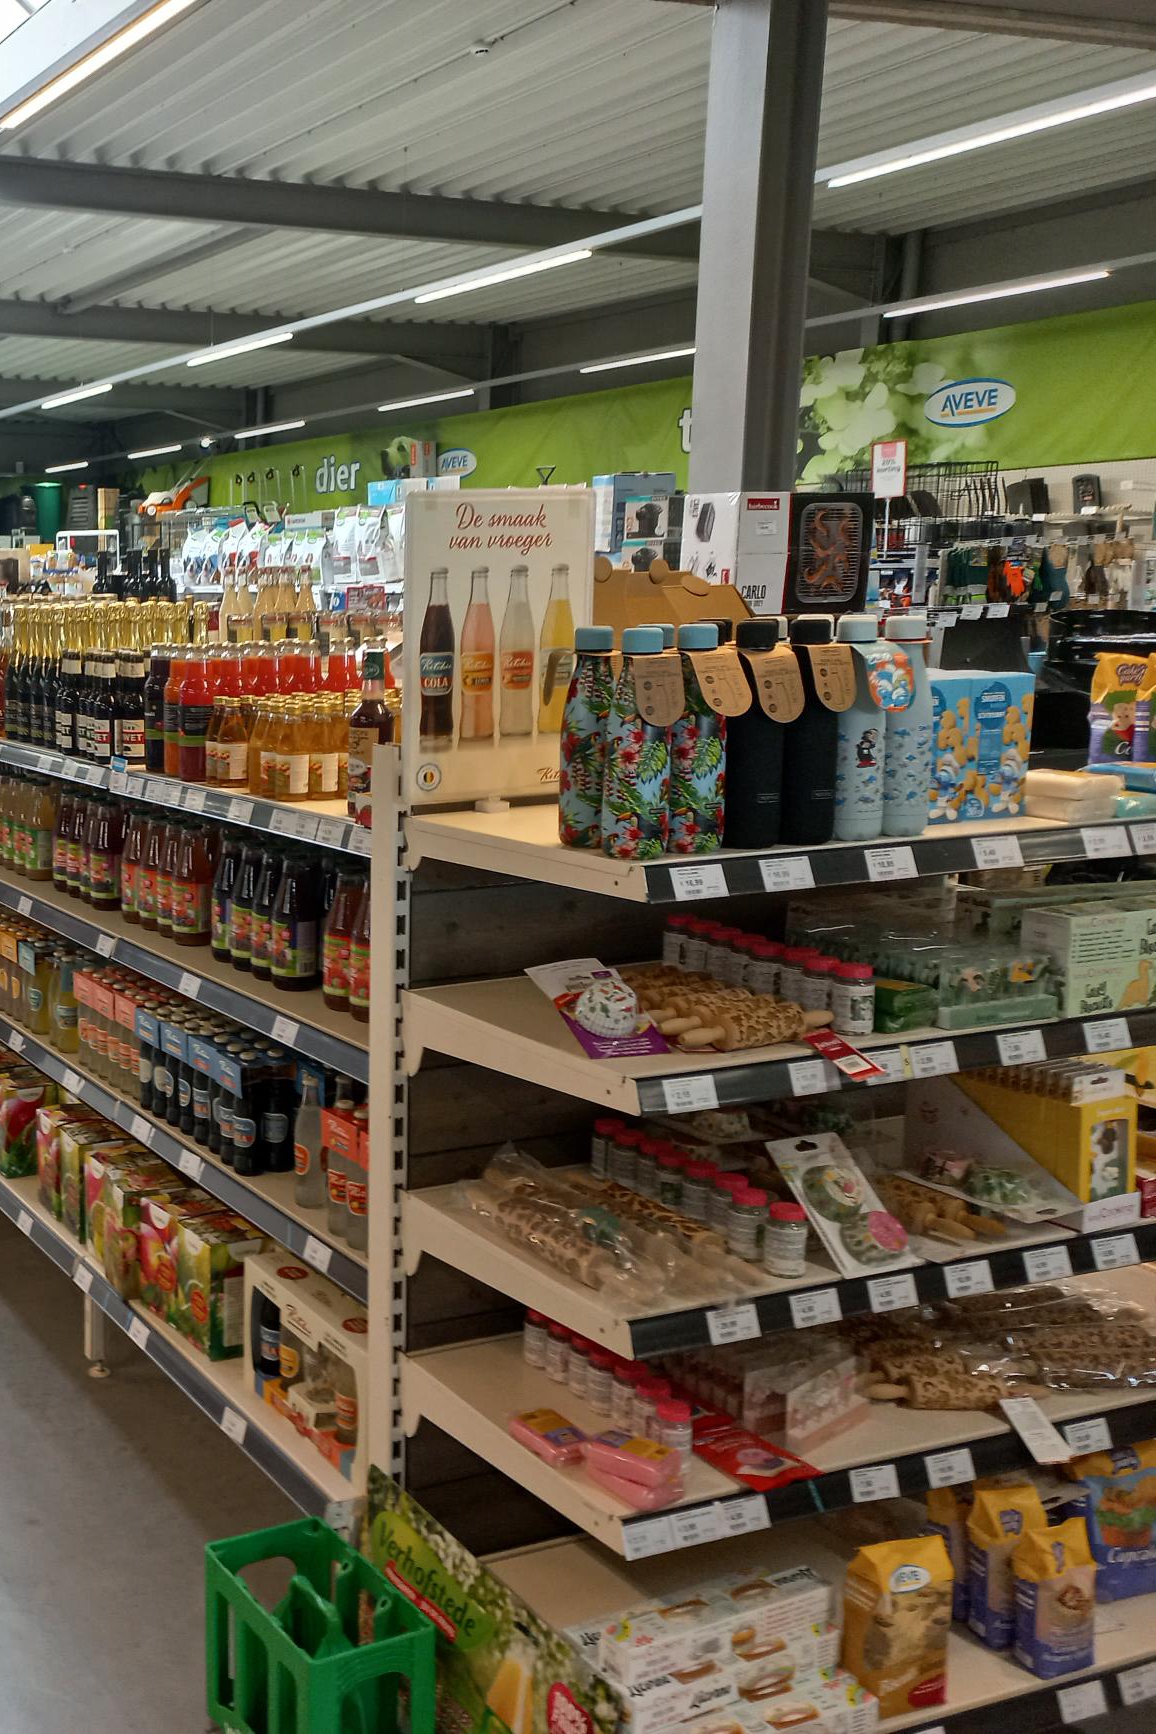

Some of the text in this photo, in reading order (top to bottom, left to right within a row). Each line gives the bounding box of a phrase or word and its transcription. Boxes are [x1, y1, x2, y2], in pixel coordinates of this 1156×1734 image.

[941, 387, 998, 416] AVEVE
[315, 455, 360, 493] dier
[442, 455, 469, 468] AVEVE
[456, 502, 547, 530] De smaak
[449, 533, 552, 555] van vroeger
[741, 585, 766, 600] CARLO
[424, 677, 449, 688] COLA
[379, 1518, 478, 1638] Verhofstede
